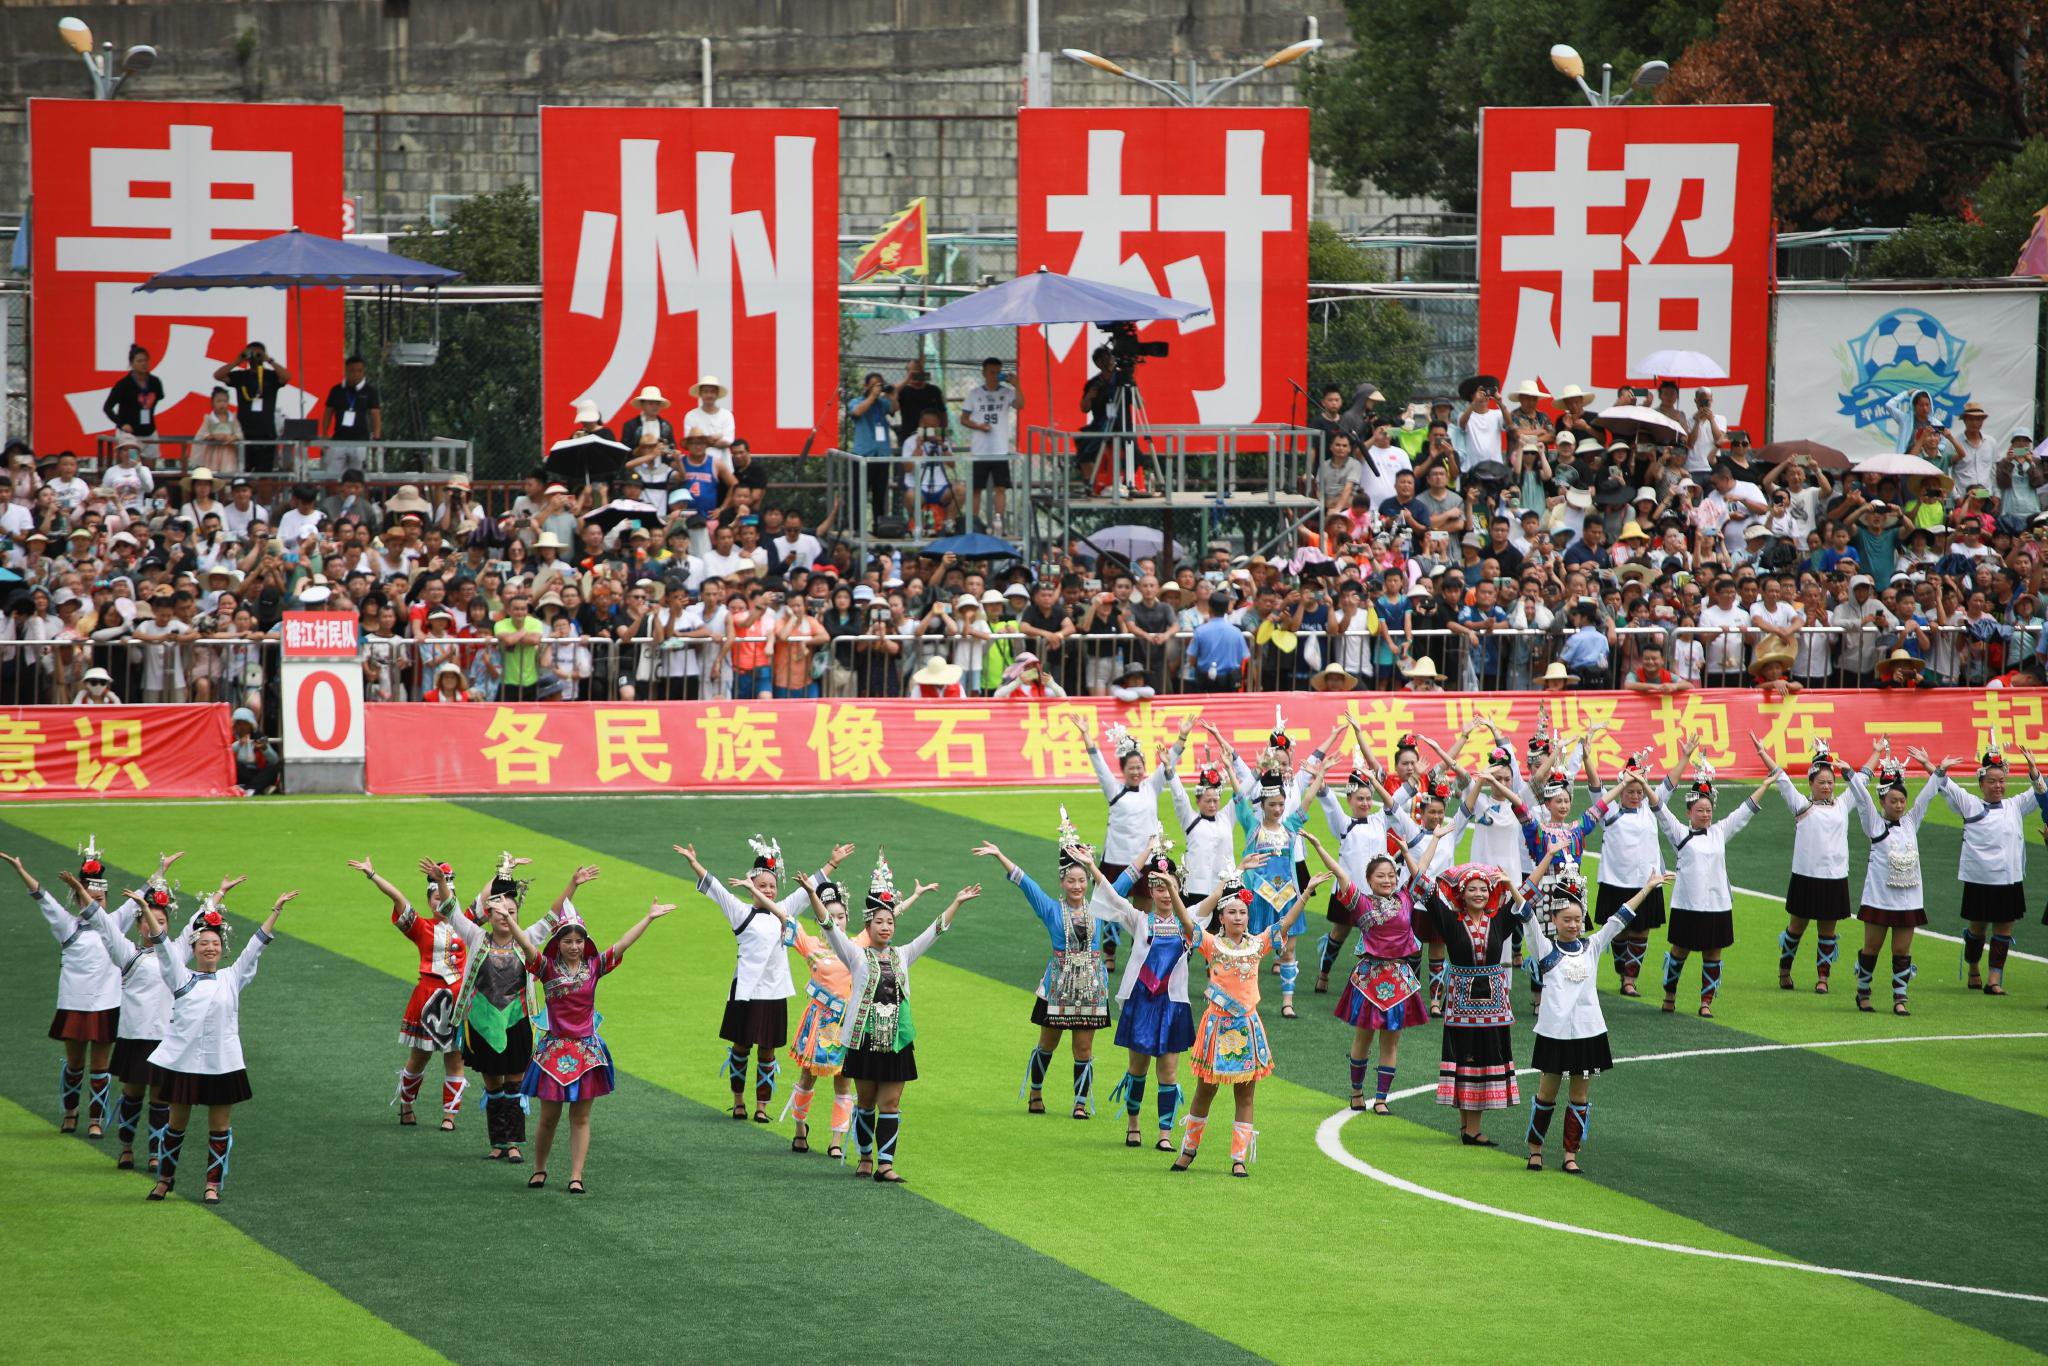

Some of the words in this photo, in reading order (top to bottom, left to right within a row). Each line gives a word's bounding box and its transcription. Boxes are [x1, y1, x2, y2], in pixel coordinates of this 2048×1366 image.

[56, 124, 319, 435] 贵
[569, 136, 814, 430] 州
[1038, 130, 1292, 425] 村
[1500, 128, 1748, 428] 超
[297, 670, 351, 751] 0
